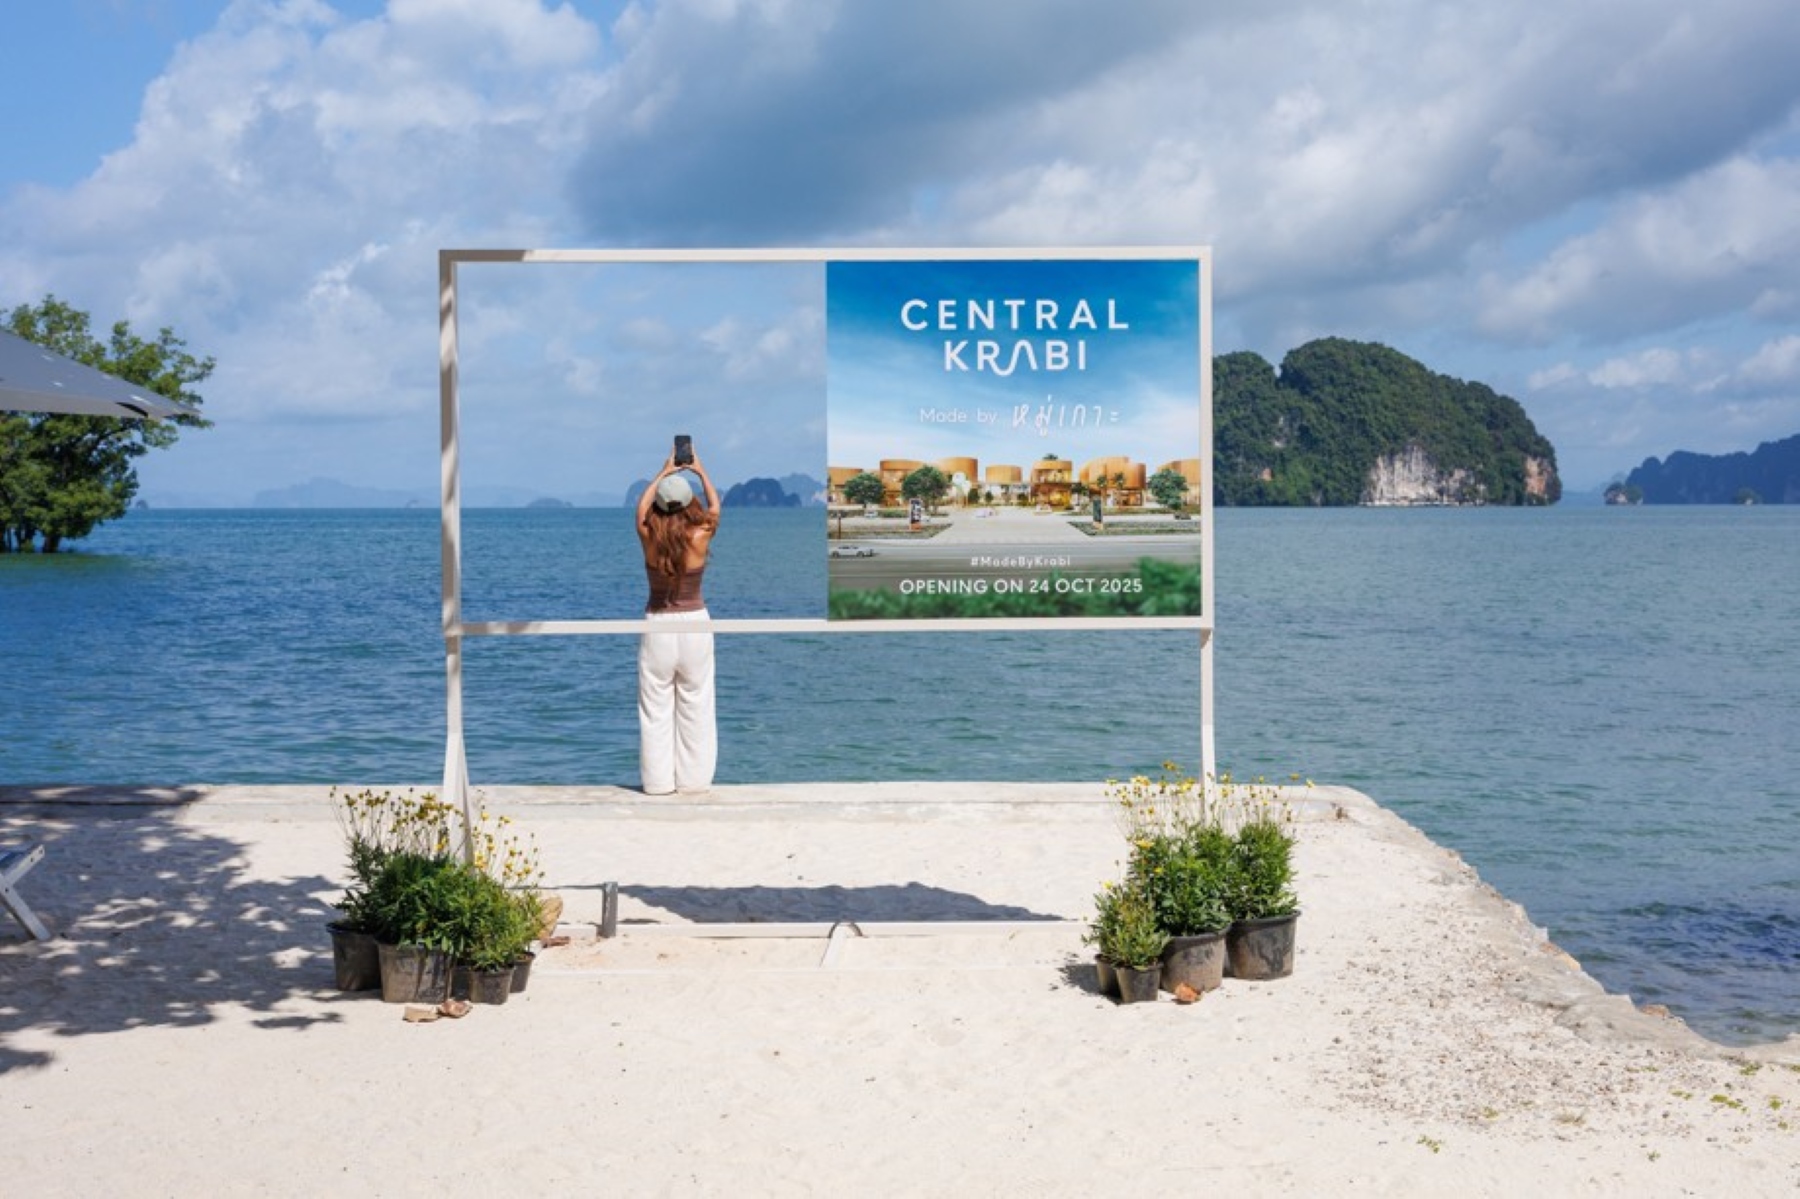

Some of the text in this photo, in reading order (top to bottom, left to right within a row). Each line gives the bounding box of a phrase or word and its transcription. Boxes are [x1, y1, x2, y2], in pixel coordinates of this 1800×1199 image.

[901, 299, 1129, 330] CENTRAL
[945, 340, 1086, 376] KRABI
[920, 395, 1121, 437] Made by หมู่เกาะ
[970, 555, 1071, 568] #MadeByKrabi
[900, 578, 1142, 594] OPENING ON 24 OCT 2025
